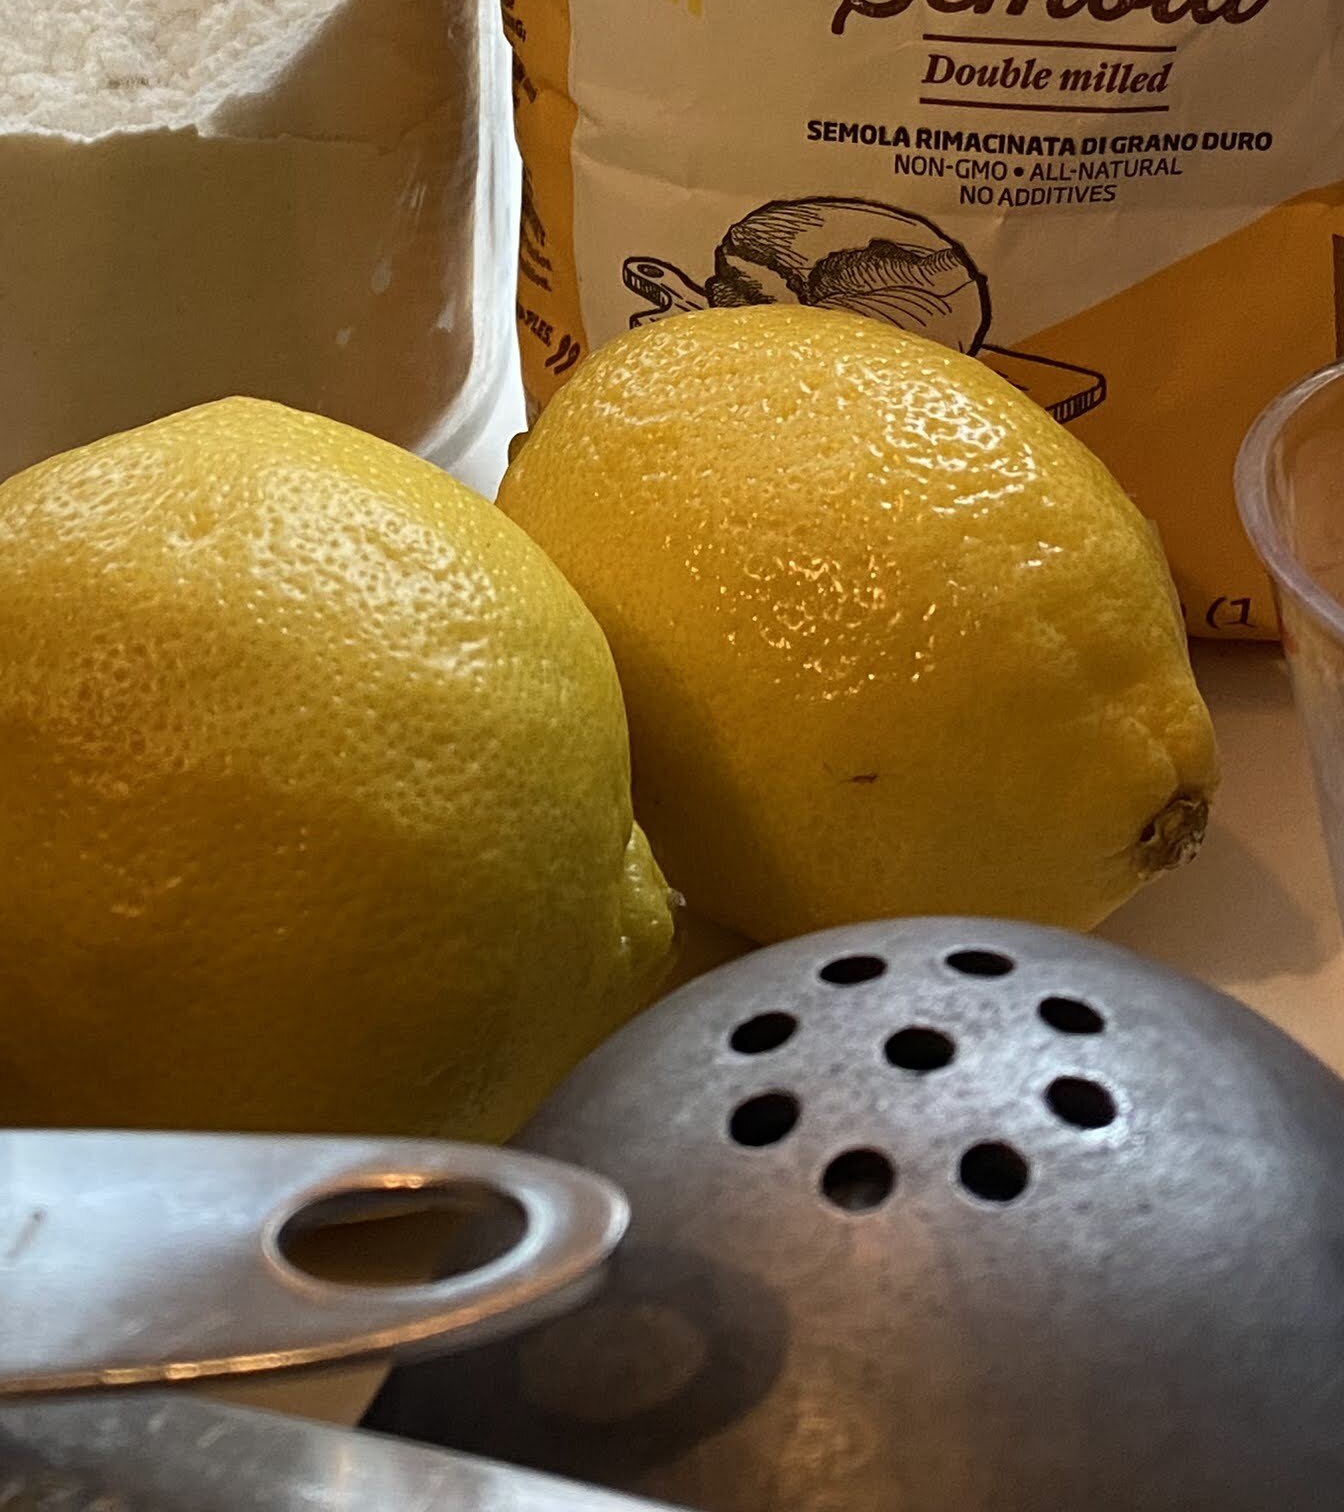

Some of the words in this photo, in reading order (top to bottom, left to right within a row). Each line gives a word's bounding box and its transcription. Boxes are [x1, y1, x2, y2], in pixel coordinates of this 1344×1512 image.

[922, 55, 1053, 91] Double
[1059, 63, 1173, 95] milled
[806, 120, 910, 149] SEMOLA
[916, 129, 1075, 157] RIMACINATA
[1081, 134, 1107, 156] DI
[1111, 132, 1198, 154] GRANO
[1202, 132, 1273, 152] DURO
[894, 154, 1008, 181] NON-GMO
[1030, 157, 1183, 181] ALL-NATURAL
[959, 185, 994, 205] NO
[998, 185, 1116, 207] ADDITIVES
